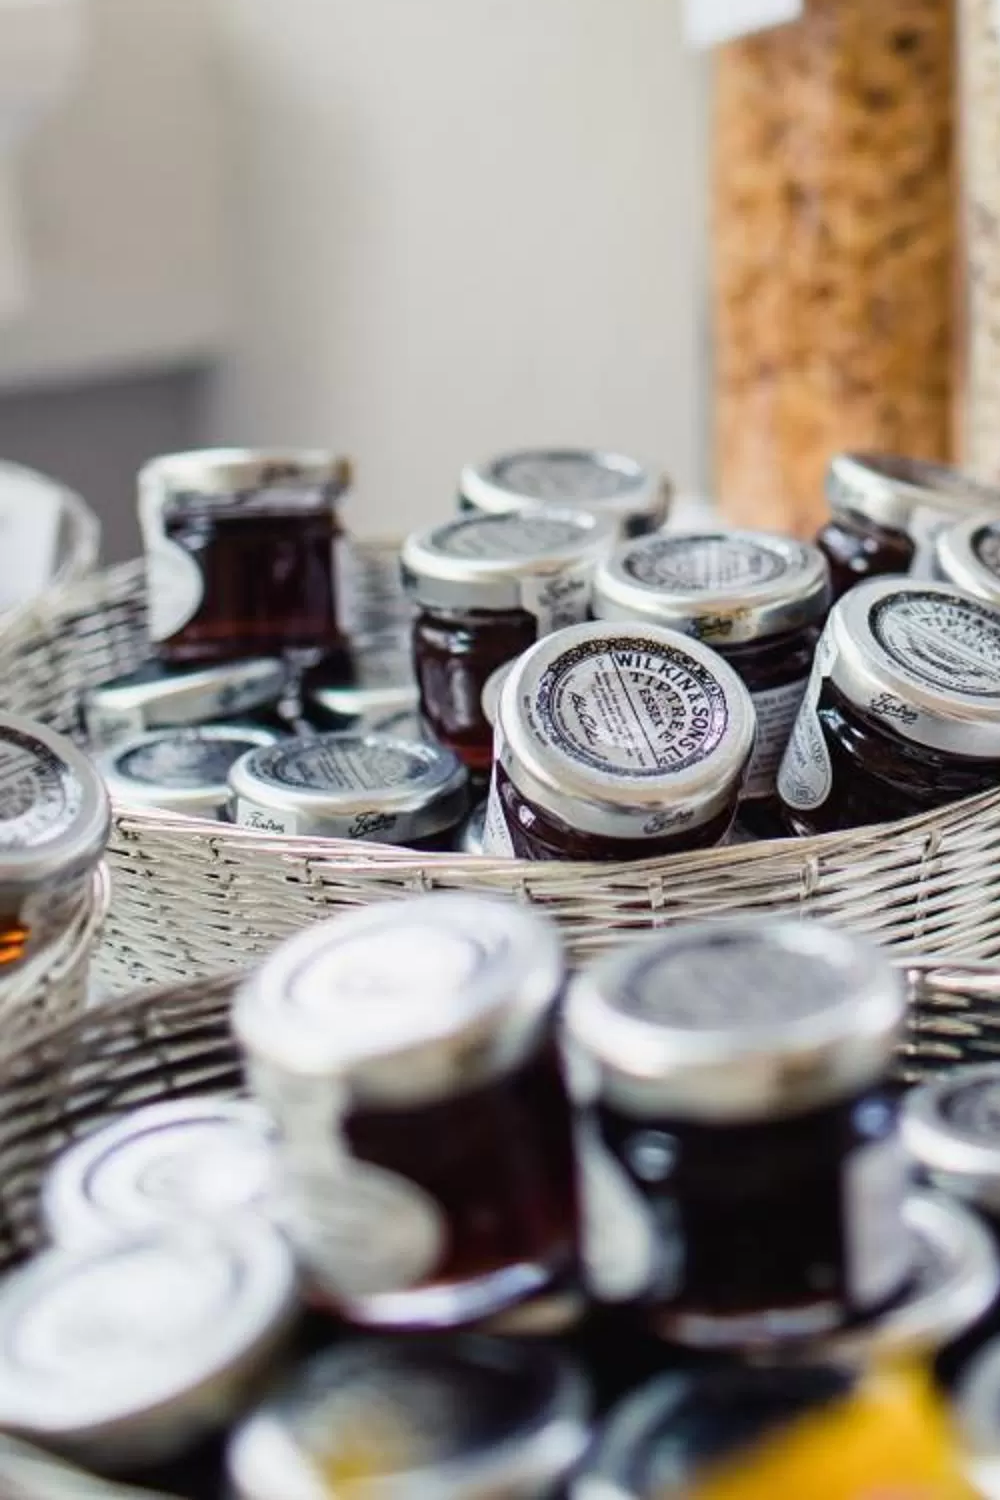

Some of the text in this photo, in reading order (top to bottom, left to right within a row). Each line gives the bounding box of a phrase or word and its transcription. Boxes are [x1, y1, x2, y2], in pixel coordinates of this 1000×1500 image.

[614, 653, 697, 691] WILKIN
[629, 671, 687, 743] TIPTREE
[638, 688, 664, 728] ESSEX
[687, 692, 705, 704] &
[678, 705, 709, 751] SONS
